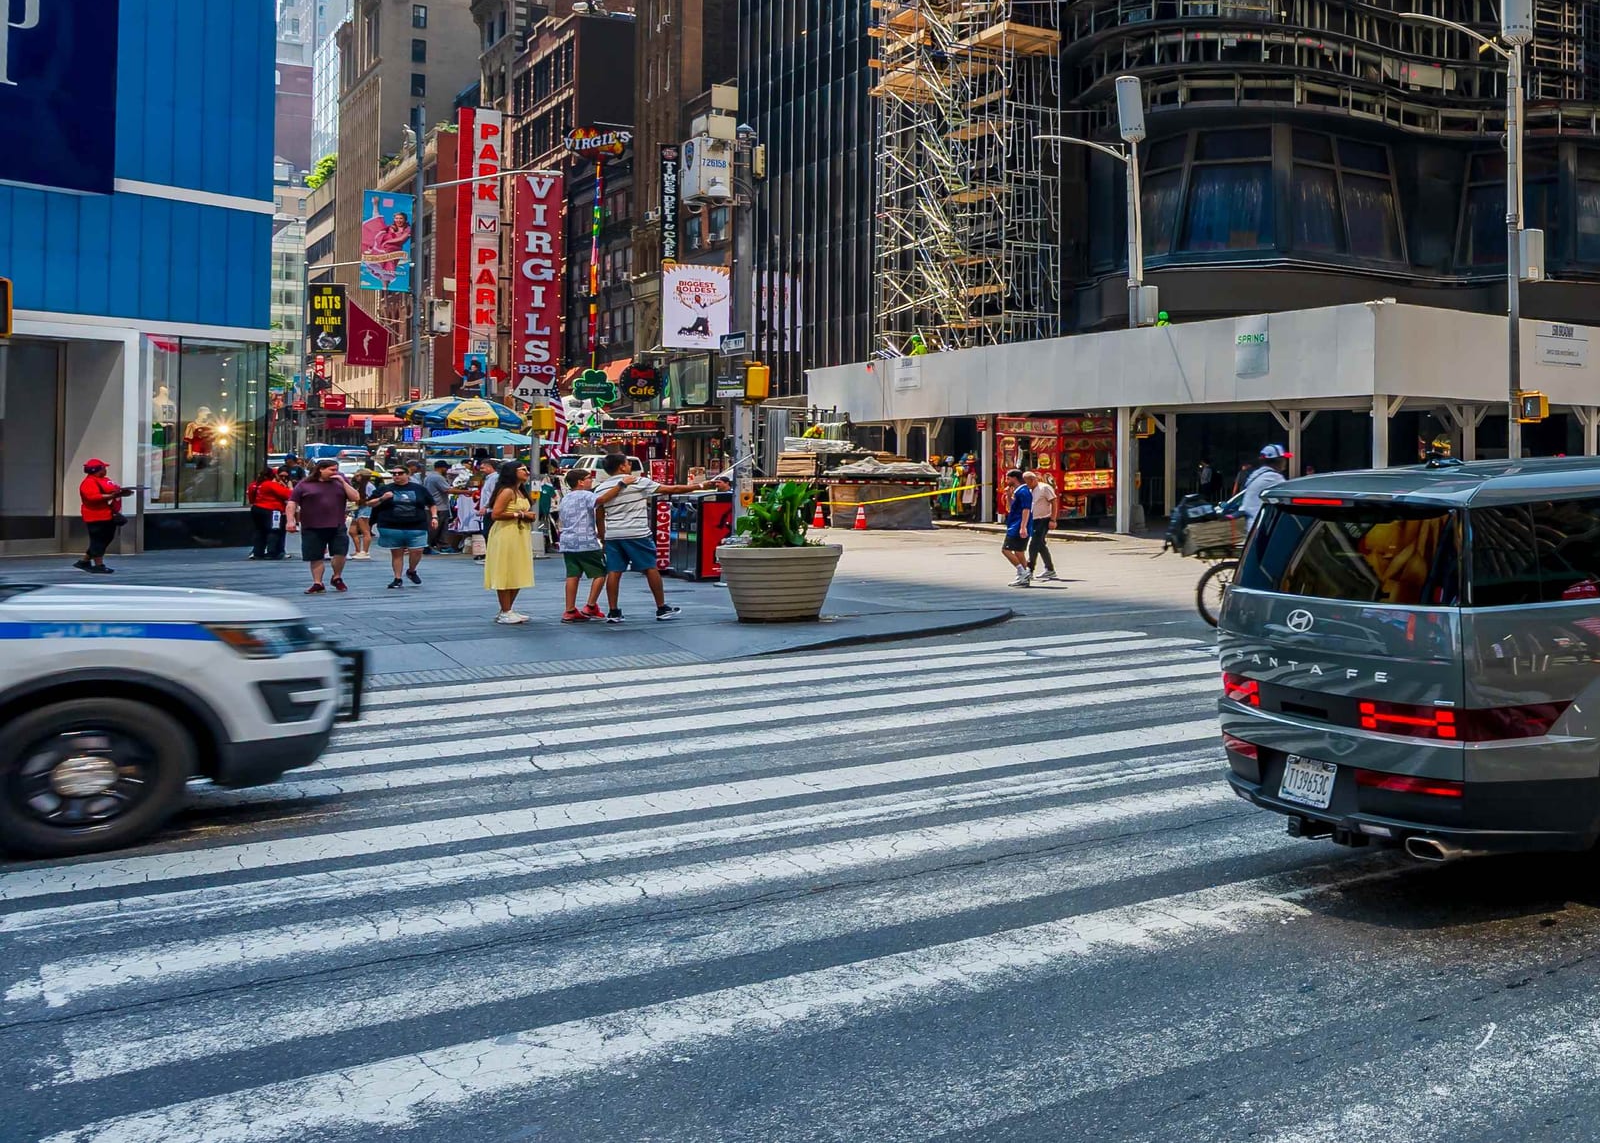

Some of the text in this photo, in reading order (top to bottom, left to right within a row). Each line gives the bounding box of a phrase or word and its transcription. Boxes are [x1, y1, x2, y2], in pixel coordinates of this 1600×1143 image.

[564, 130, 632, 151] VIRGIL'S
[478, 124, 500, 202] PARK
[702, 158, 727, 169] 726158
[663, 161, 676, 194] TIMES
[663, 195, 676, 223] DELI
[663, 231, 676, 258] CAFE
[522, 176, 556, 363] VIRGILS
[476, 248, 497, 326] PARK
[678, 280, 715, 289] BIGGEST
[314, 295, 341, 310] CATS
[1237, 333, 1265, 344] SPRING
[518, 364, 556, 377] BBQ
[629, 386, 656, 396] Café
[657, 502, 671, 570] CHICAGO
[1346, 669, 1388, 683] FE
[1288, 767, 1329, 796] T139653C
